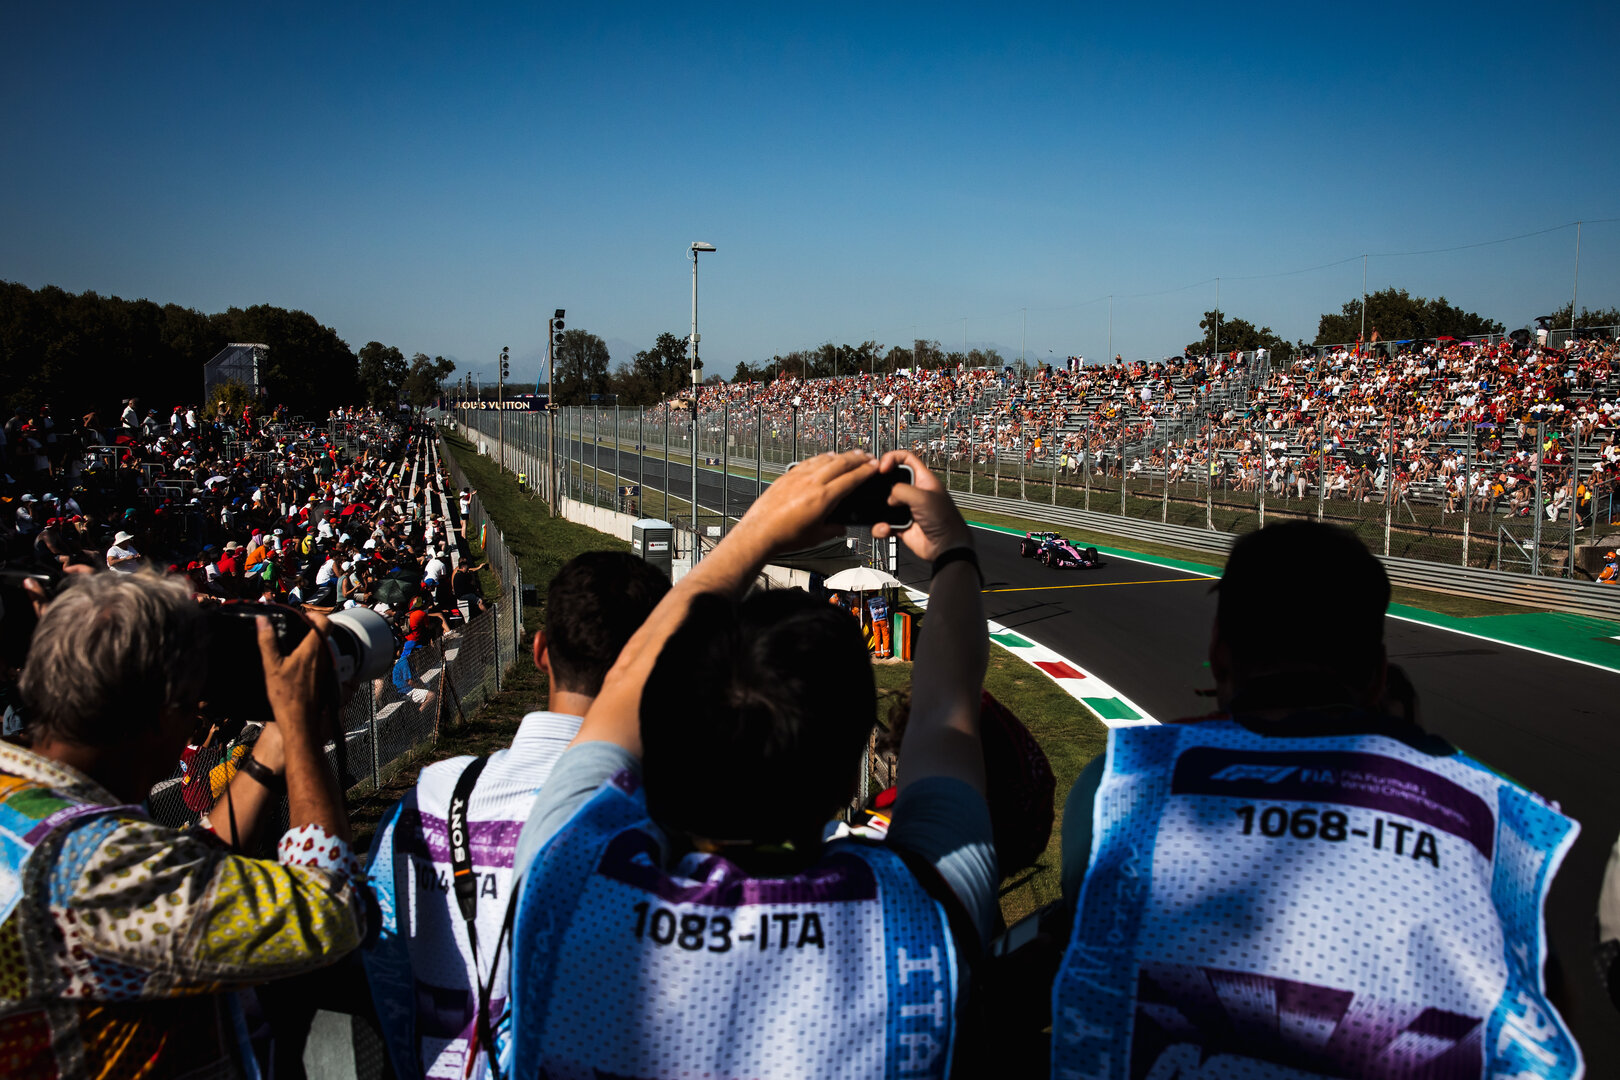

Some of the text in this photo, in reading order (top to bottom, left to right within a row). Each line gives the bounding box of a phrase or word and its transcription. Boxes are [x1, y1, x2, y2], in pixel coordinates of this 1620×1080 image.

[488, 401, 531, 410] VUITTON
[450, 797, 466, 863] SONY
[1236, 806, 1440, 868] 1068-ITA
[631, 900, 826, 953] 1083-ITA
